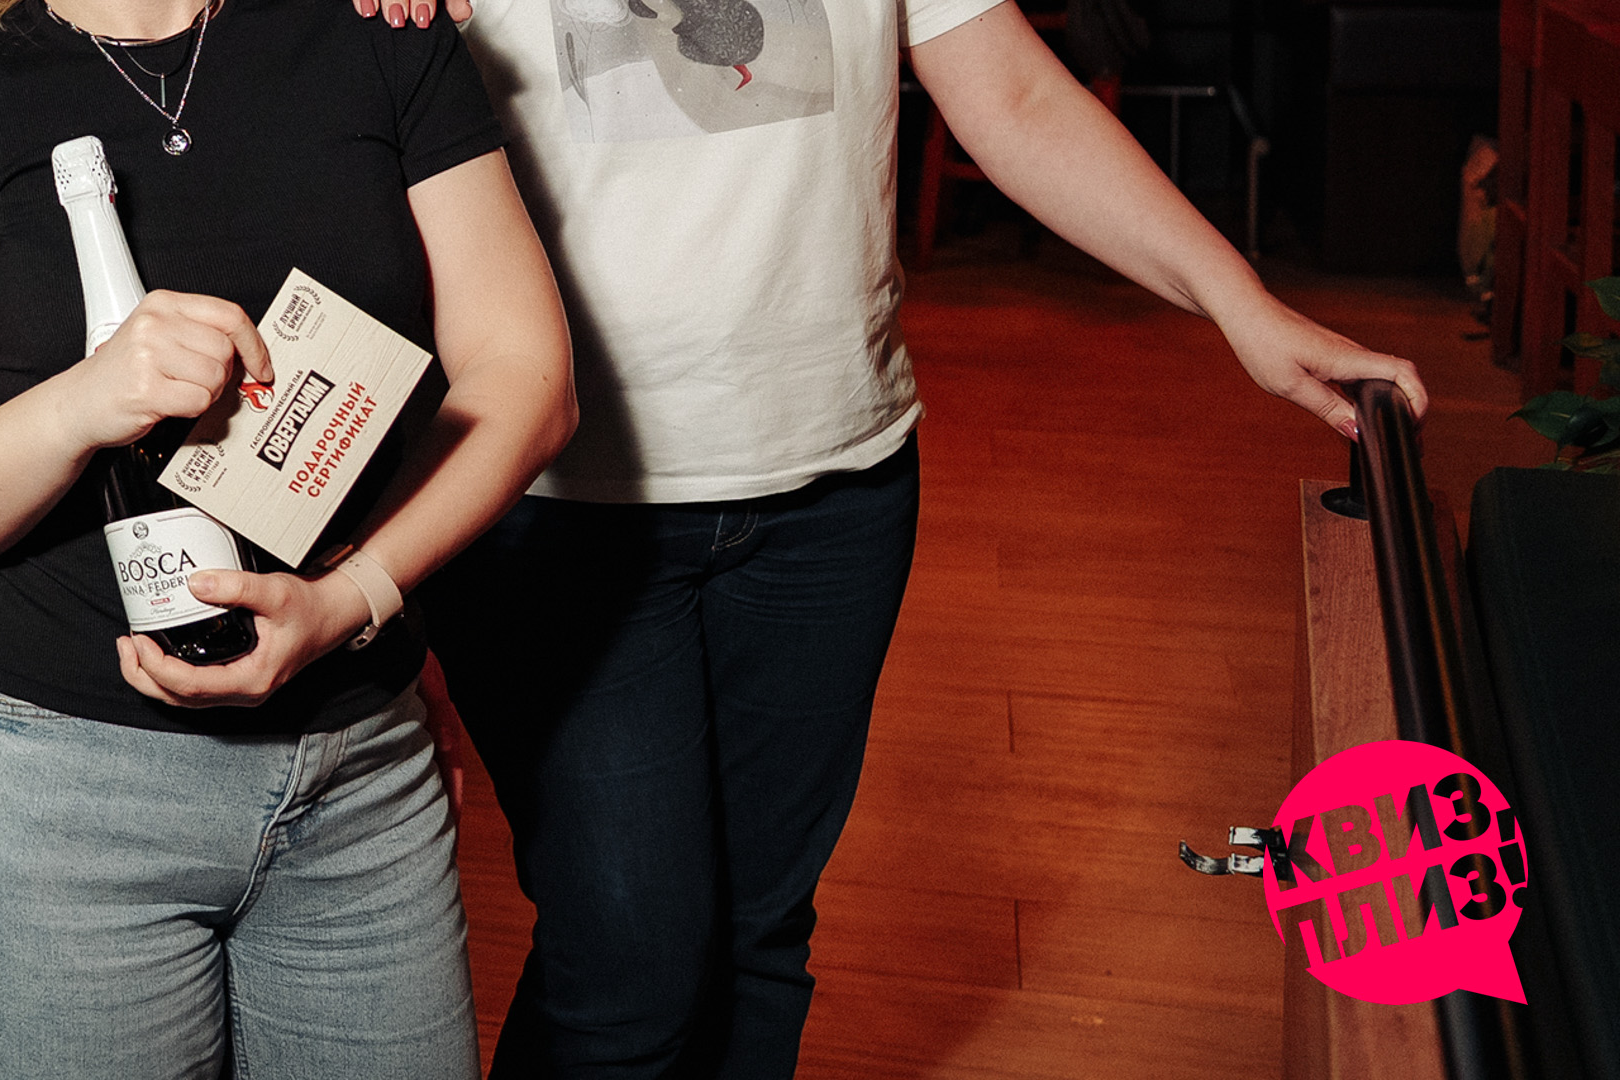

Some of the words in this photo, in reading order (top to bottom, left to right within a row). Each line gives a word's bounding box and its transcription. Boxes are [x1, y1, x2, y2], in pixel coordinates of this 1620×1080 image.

[249, 383, 295, 449] ГАСТРОНОМИЧЕСКИЙ
[288, 381, 366, 494] ПОДАРОЧНЫЙ
[307, 396, 377, 497] СЕРТИФИКАТ
[118, 548, 197, 582] BOSCA
[148, 575, 188, 593] FEDERI
